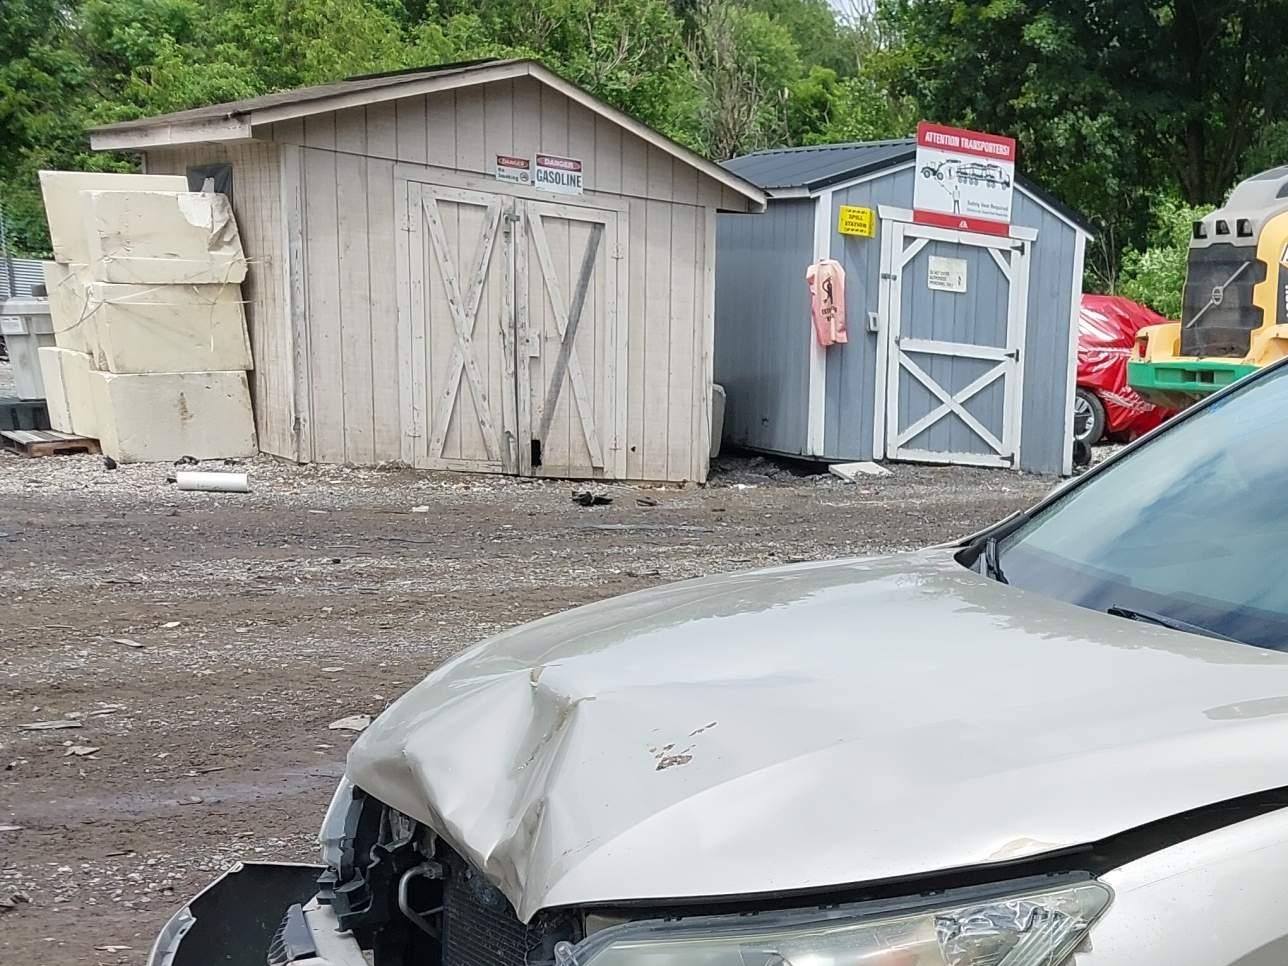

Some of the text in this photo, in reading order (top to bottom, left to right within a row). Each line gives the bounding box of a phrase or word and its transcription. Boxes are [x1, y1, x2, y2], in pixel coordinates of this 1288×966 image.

[925, 131, 960, 147] ATTENTION
[544, 158, 574, 169] DANGER
[536, 169, 582, 188] GASOLINE
